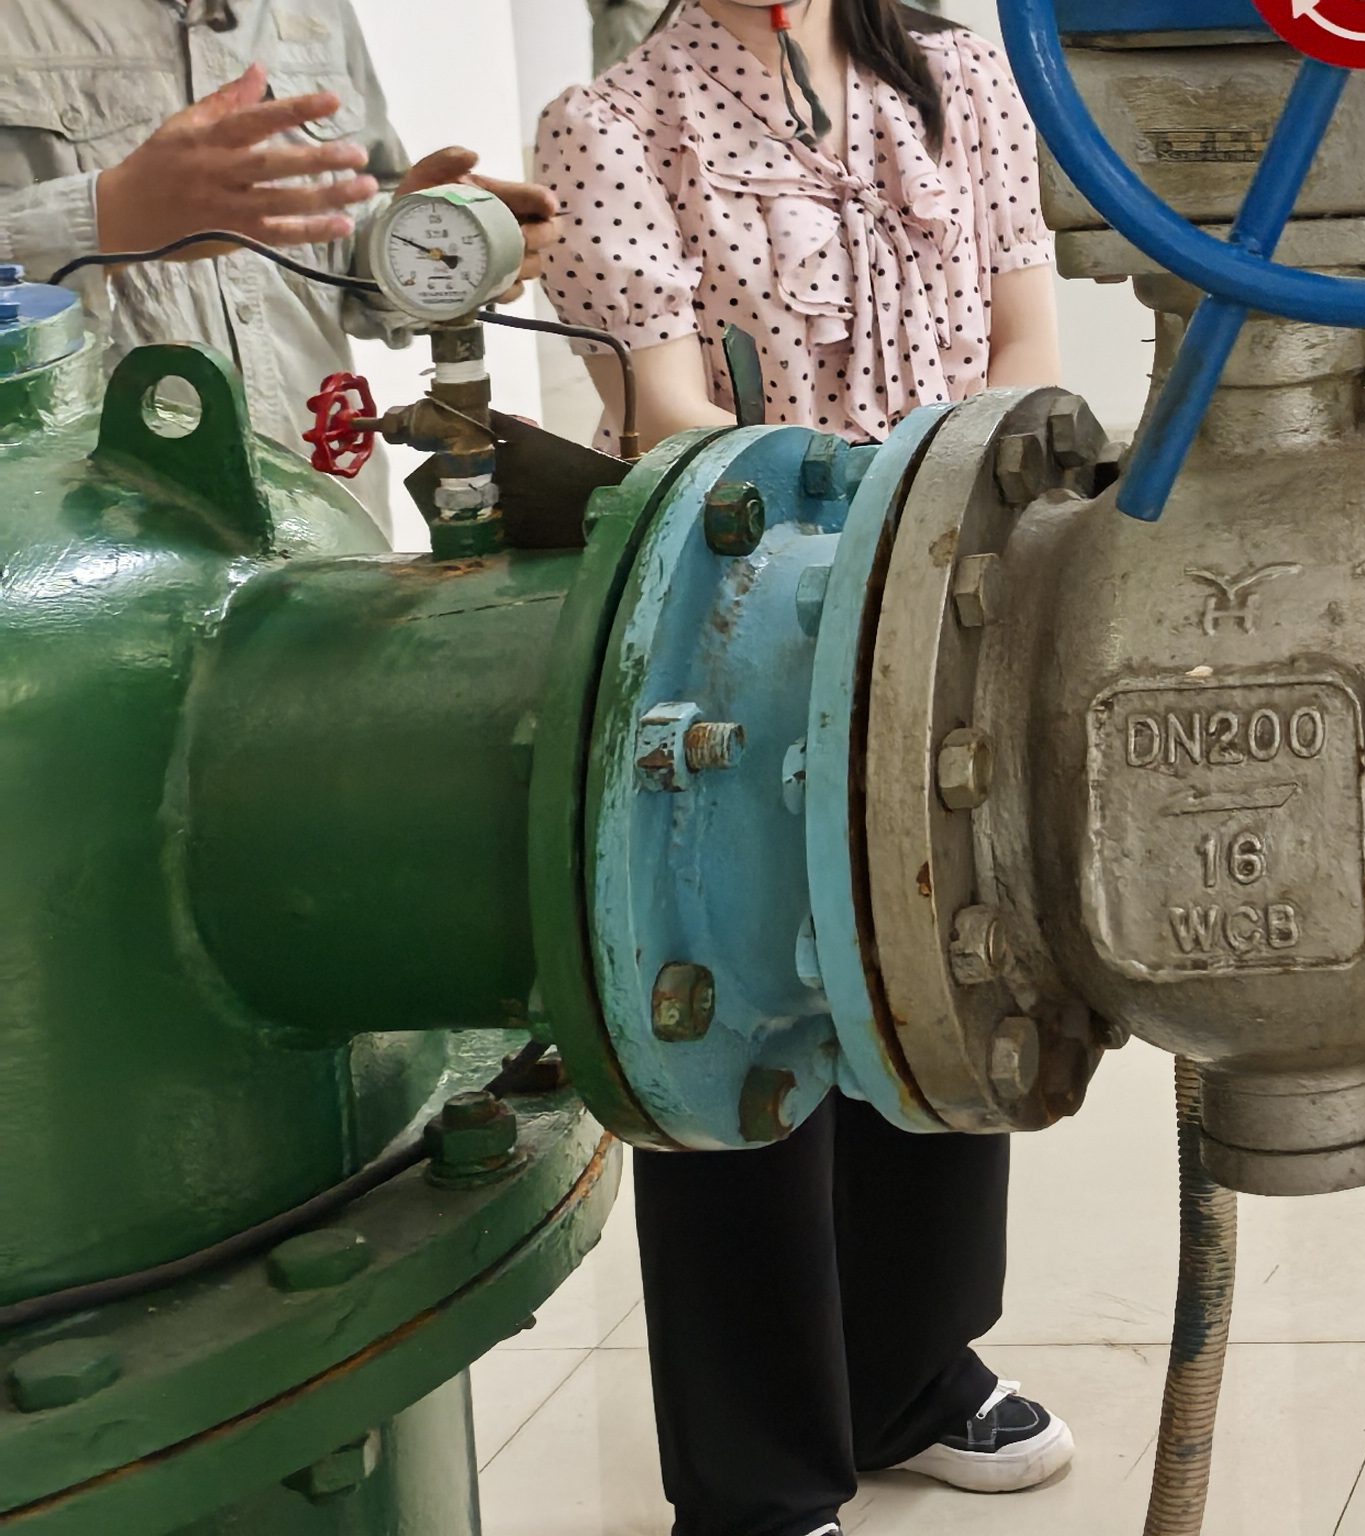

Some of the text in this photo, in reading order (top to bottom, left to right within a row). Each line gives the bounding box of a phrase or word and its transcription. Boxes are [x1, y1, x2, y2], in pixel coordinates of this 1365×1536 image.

[1125, 706, 1327, 767] DN200
[1197, 830, 1267, 888] 16
[1168, 902, 1299, 954] WCB
